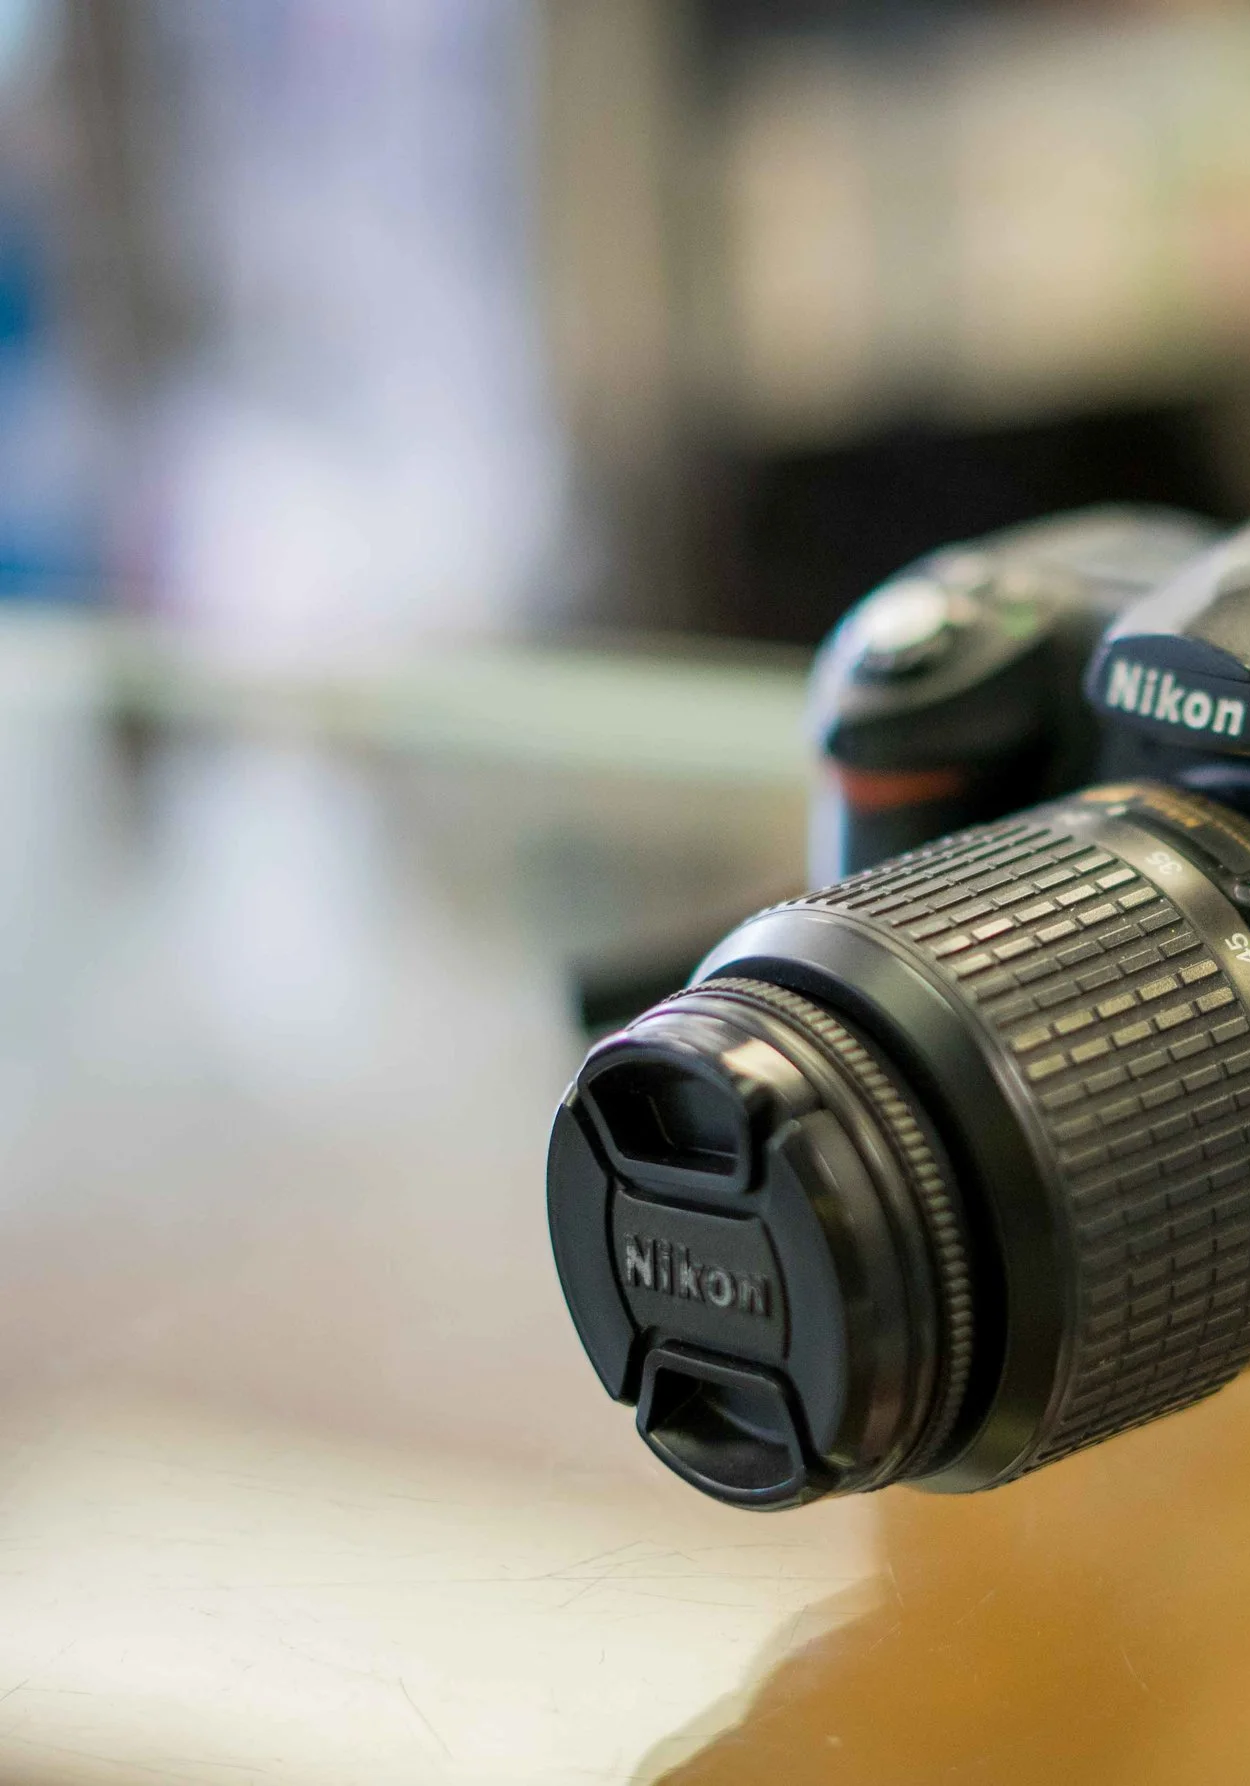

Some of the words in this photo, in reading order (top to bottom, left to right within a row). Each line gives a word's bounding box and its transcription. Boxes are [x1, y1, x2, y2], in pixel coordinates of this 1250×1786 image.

[1106, 659, 1244, 736] Nikon
[1145, 850, 1183, 876] 35
[623, 1232, 774, 1318] Nikon
